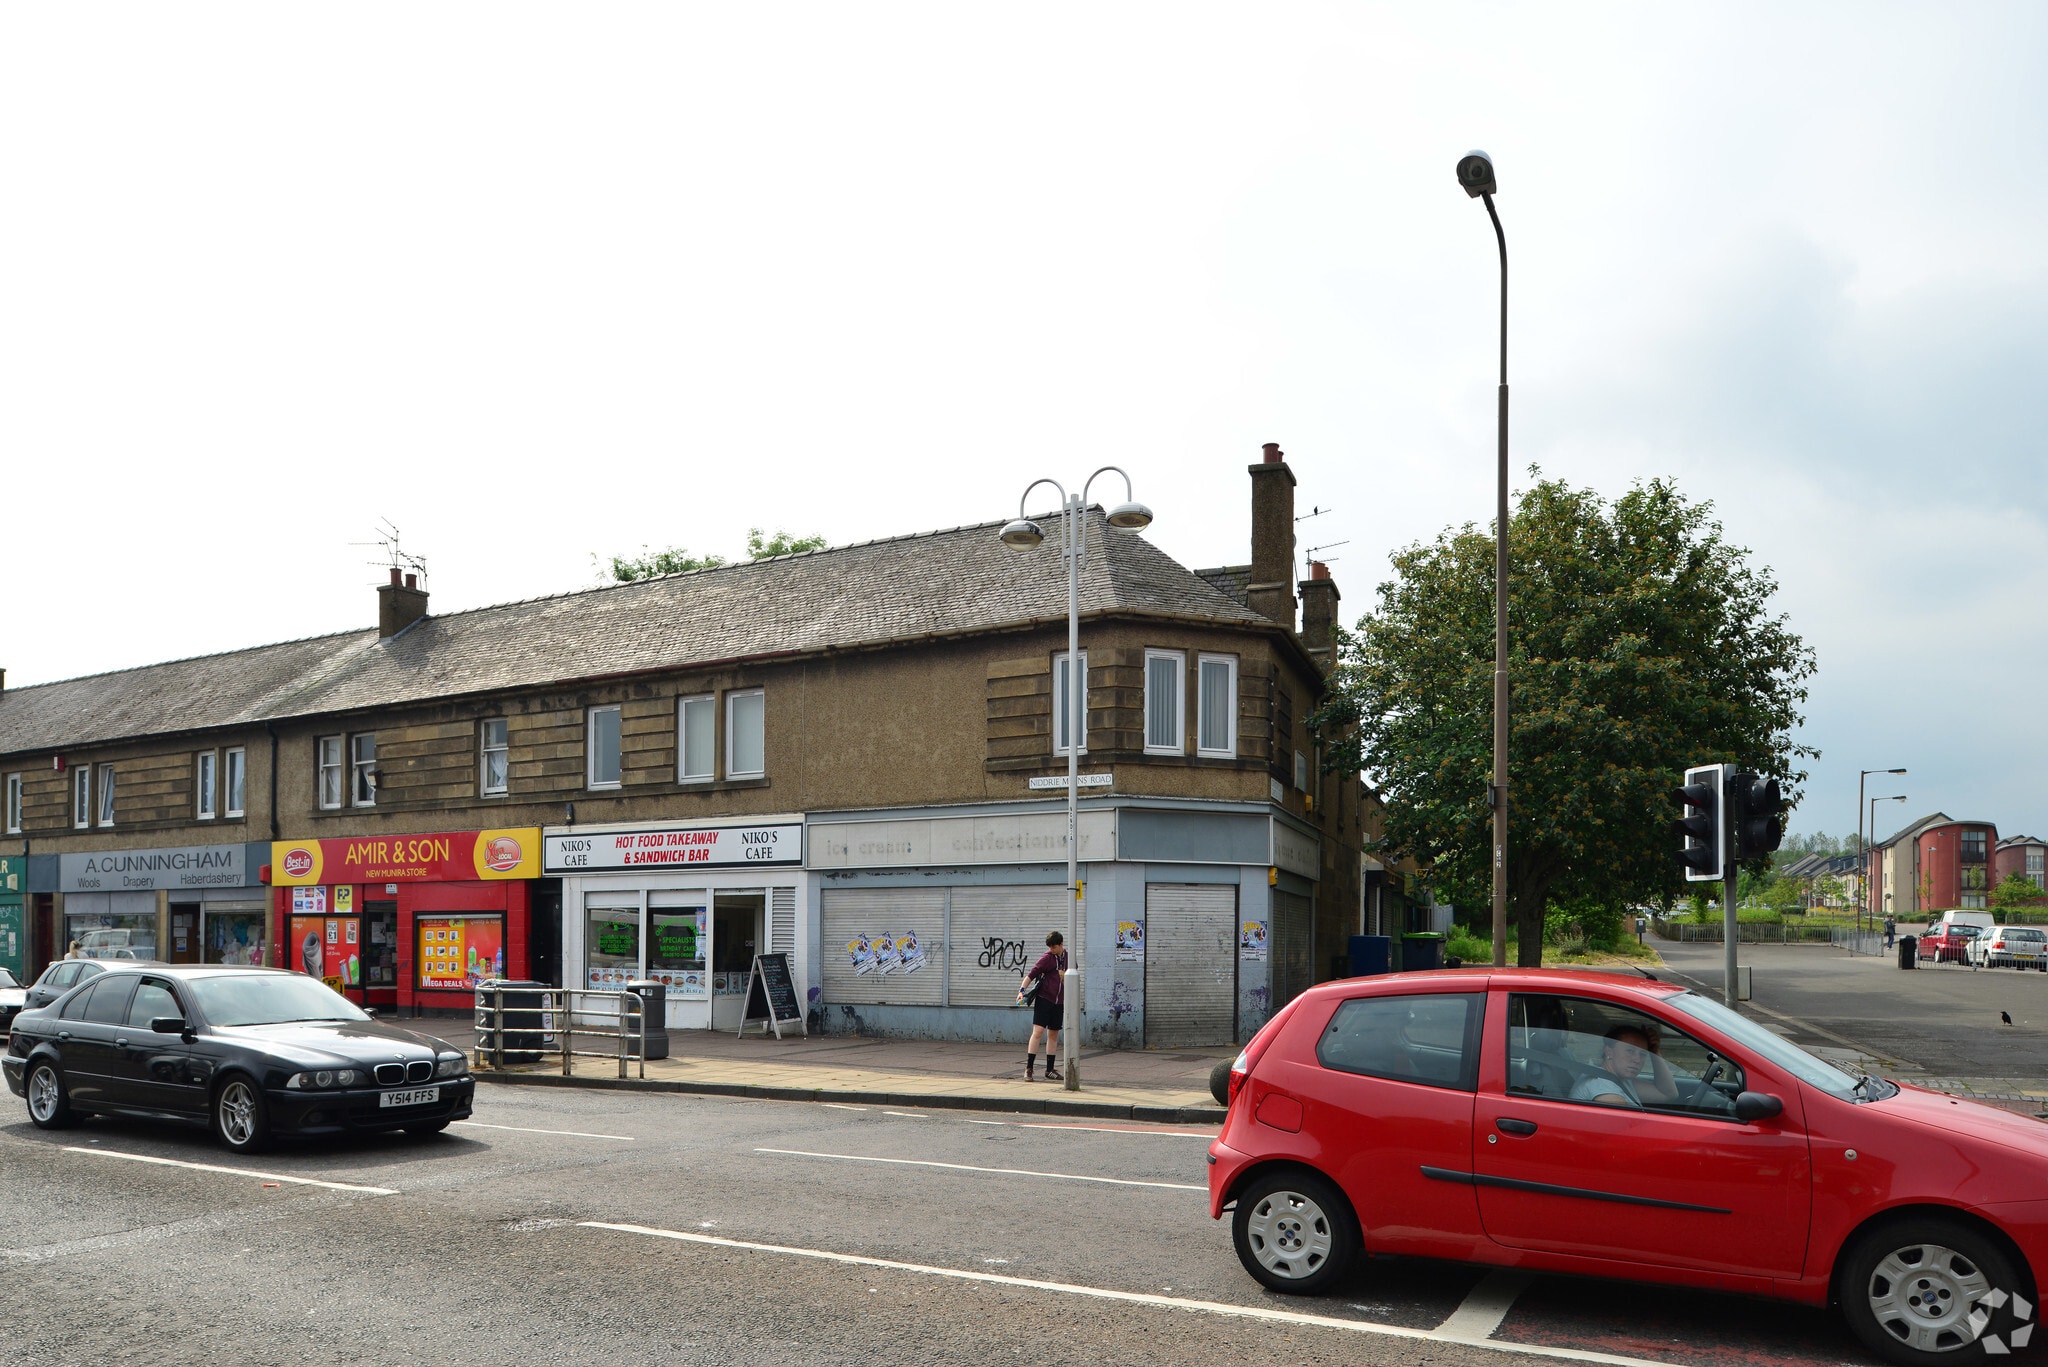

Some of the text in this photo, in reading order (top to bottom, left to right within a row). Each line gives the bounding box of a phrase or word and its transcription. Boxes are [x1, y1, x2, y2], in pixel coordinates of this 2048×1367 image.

[1030, 775, 1112, 787] NIDDRIE MNS ROAD
[615, 832, 719, 848] HOT FOOD TAKEAWAY
[741, 831, 778, 844] NIKO'S
[345, 839, 449, 865] AMIR & SON
[560, 840, 592, 852] NIKO'S
[623, 849, 710, 864] & SANDWICH BAR
[745, 847, 773, 860] CAFE
[0, 860, 8, 873] R
[564, 854, 588, 867] CAFE
[365, 868, 427, 878] NEW MUNIRA STORE
[77, 873, 242, 888] Wools Drapery Haberdashery
[662, 936, 696, 944] SPECIALISTS
[422, 975, 443, 987] MEGA
[388, 1090, 434, 1104] Y514 FFS
